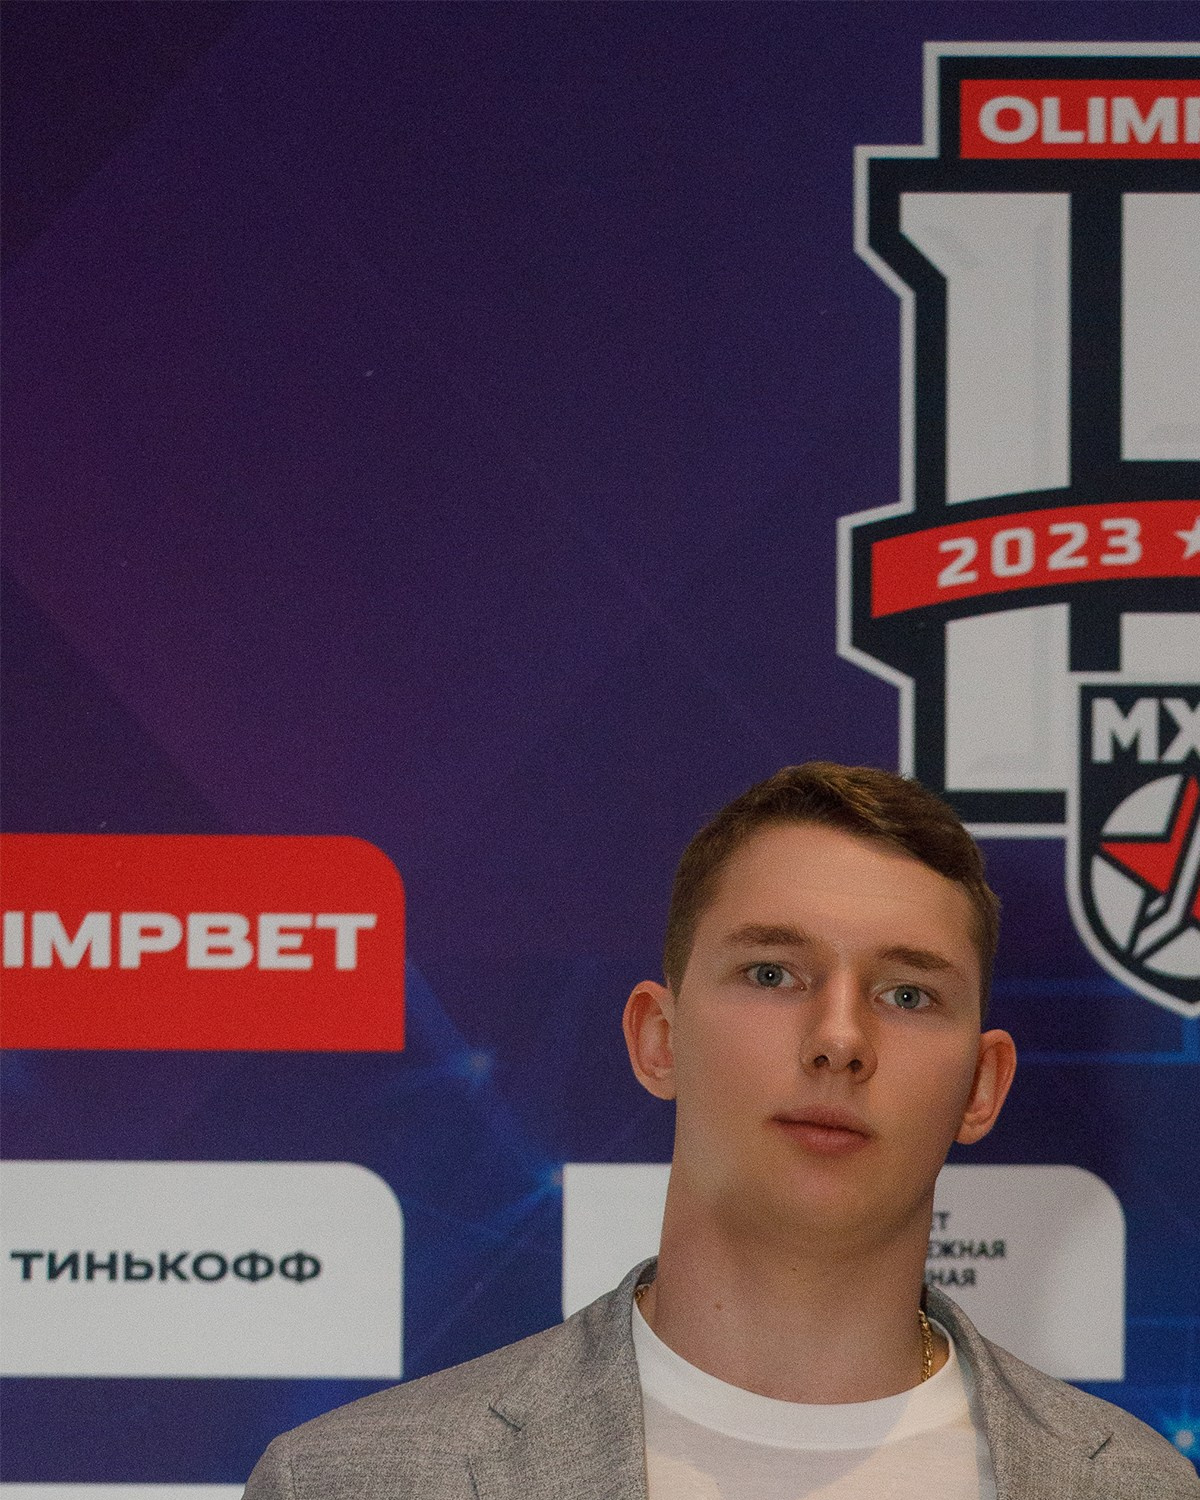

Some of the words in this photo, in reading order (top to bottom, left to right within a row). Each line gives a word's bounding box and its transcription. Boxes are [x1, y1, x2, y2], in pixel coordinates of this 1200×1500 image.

[935, 516, 1144, 589] 2023
[2, 911, 378, 971] IMPBET
[10, 1249, 322, 1283] ТИНЬКОФФ
